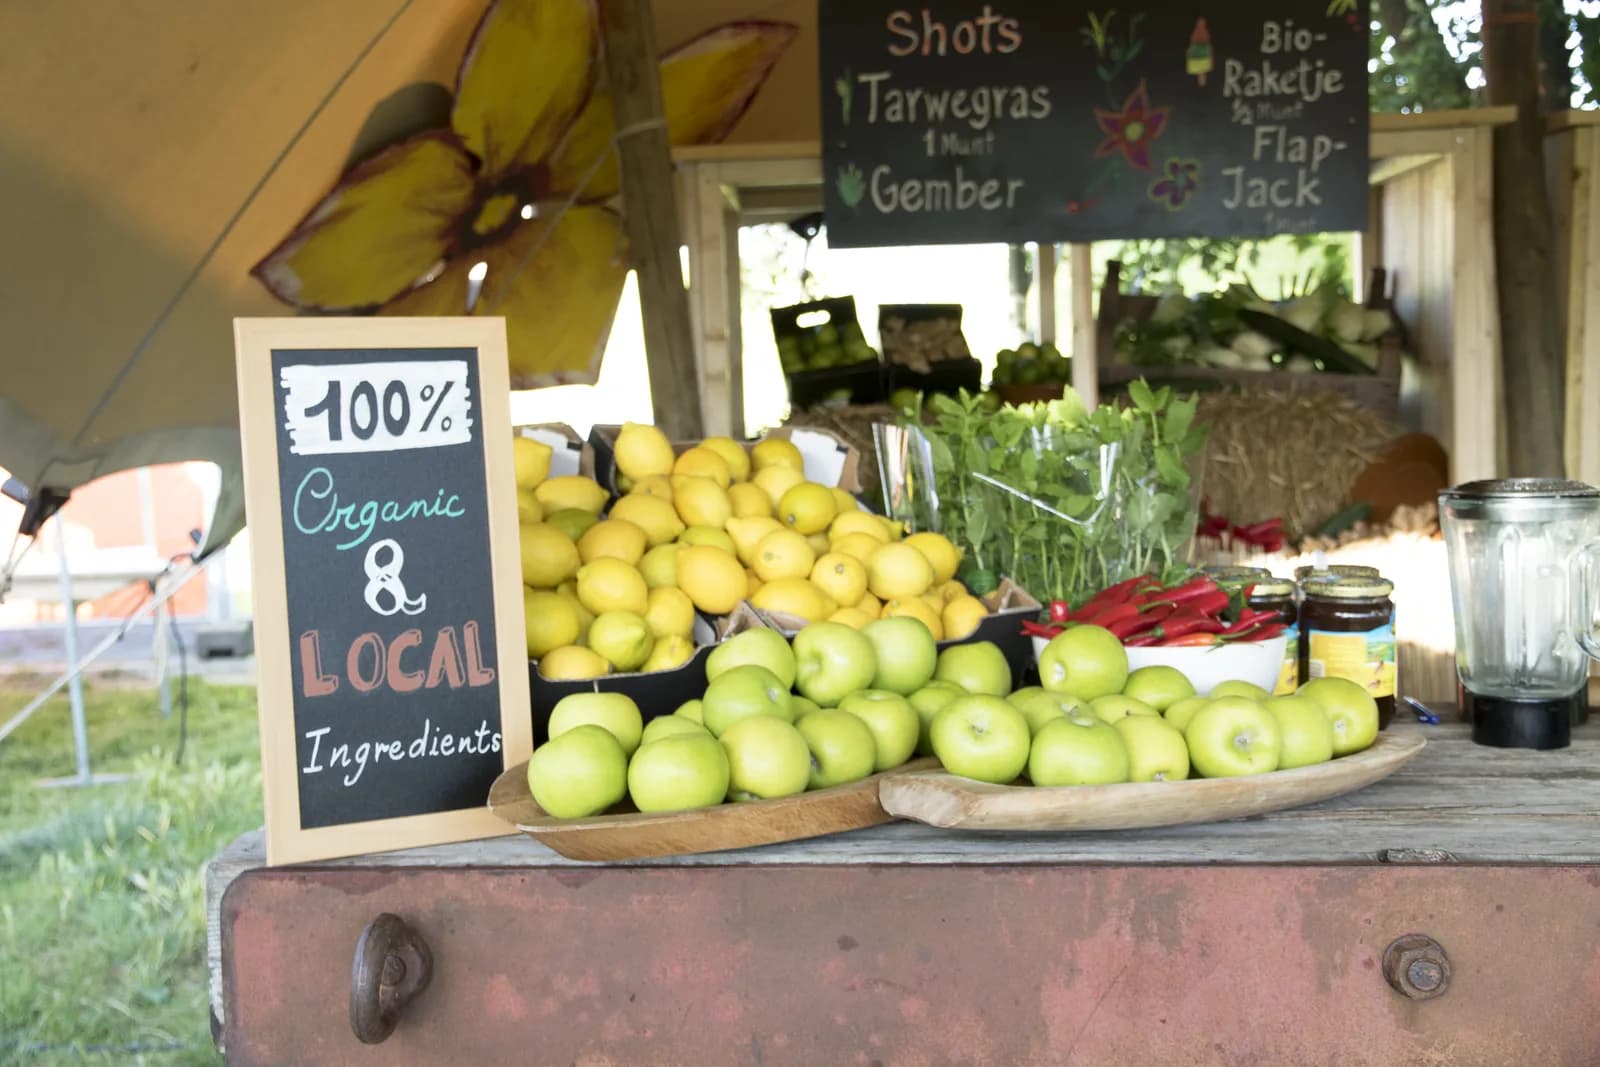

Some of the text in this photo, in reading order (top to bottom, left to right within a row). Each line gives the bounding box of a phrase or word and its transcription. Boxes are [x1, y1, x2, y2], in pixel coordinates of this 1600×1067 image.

[886, 5, 1023, 56] Shots
[1260, 19, 1328, 54] Bio-
[857, 70, 1053, 130] Tarwegras
[1222, 58, 1345, 102] Raketje
[922, 129, 995, 157] 1 Munt
[1253, 125, 1347, 172] Flap-
[870, 164, 1025, 214] Gember
[1221, 165, 1322, 209] Jack
[303, 379, 455, 441] 100%
[293, 467, 465, 550] Organic
[364, 538, 427, 616] &
[300, 620, 496, 698] LOCAL
[303, 718, 502, 787] Ingredients
